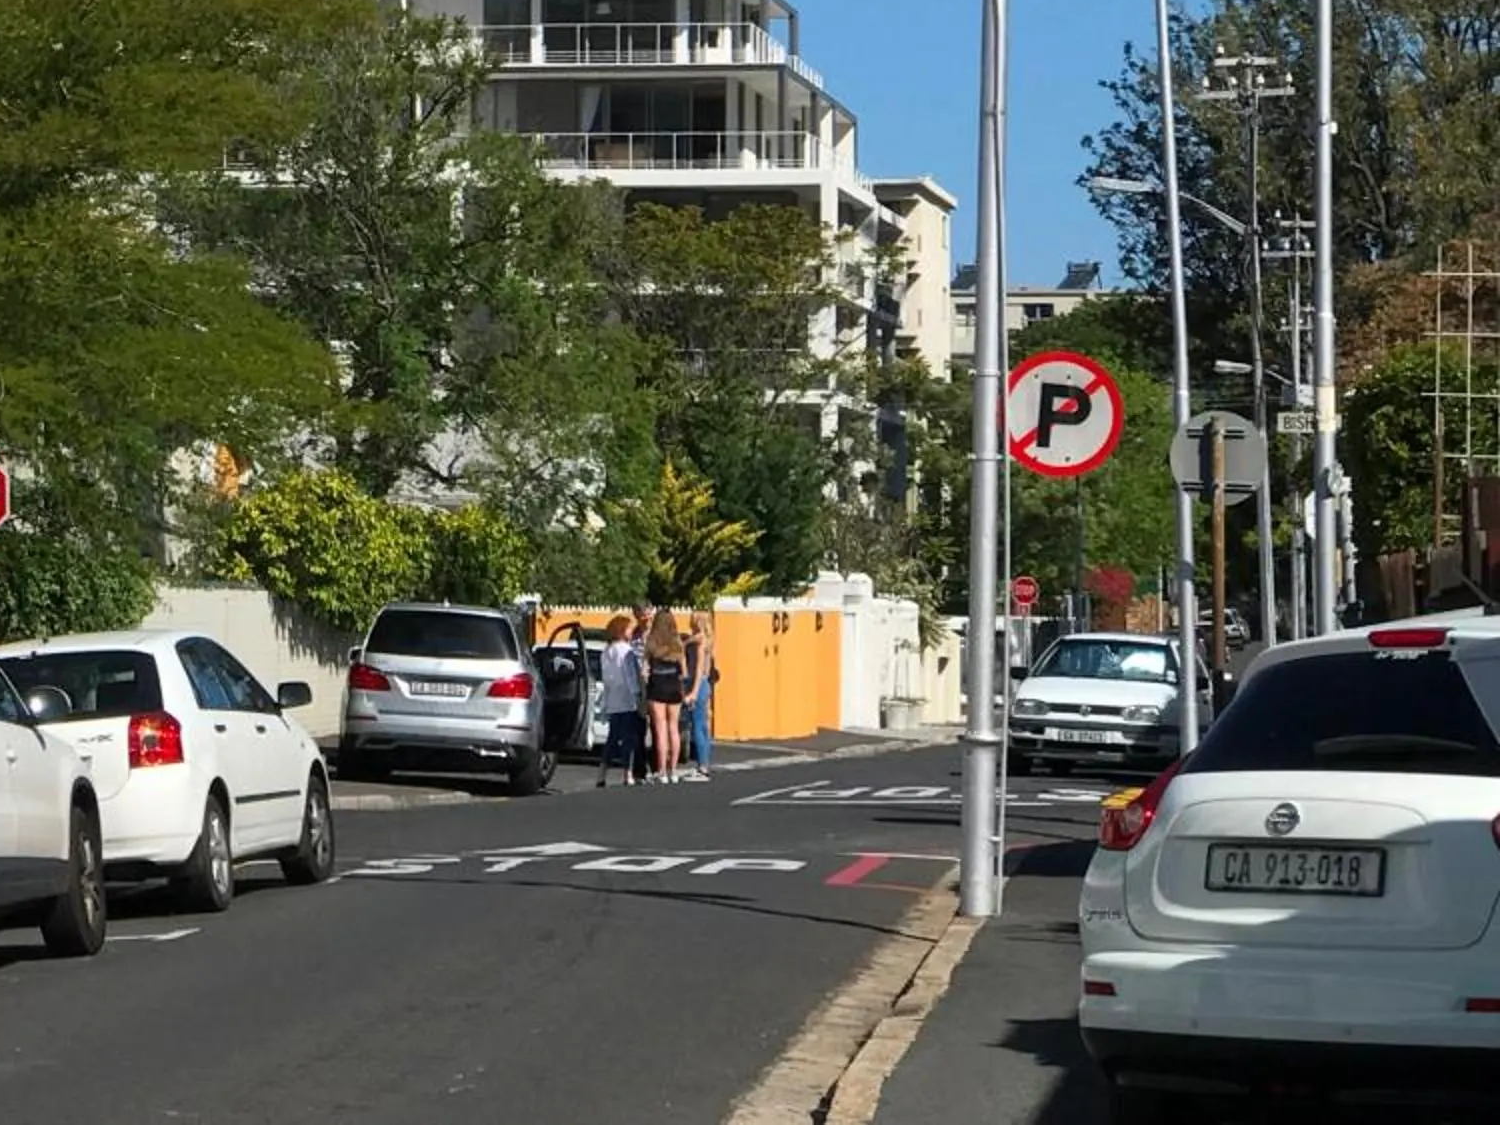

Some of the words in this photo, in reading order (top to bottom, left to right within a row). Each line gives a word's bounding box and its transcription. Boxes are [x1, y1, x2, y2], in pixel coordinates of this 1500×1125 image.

[1036, 383, 1092, 448] P
[1283, 416, 1315, 431] BISH
[350, 855, 806, 874] STOP
[1225, 852, 1251, 884] CA
[1265, 853, 1361, 887] 913-018
